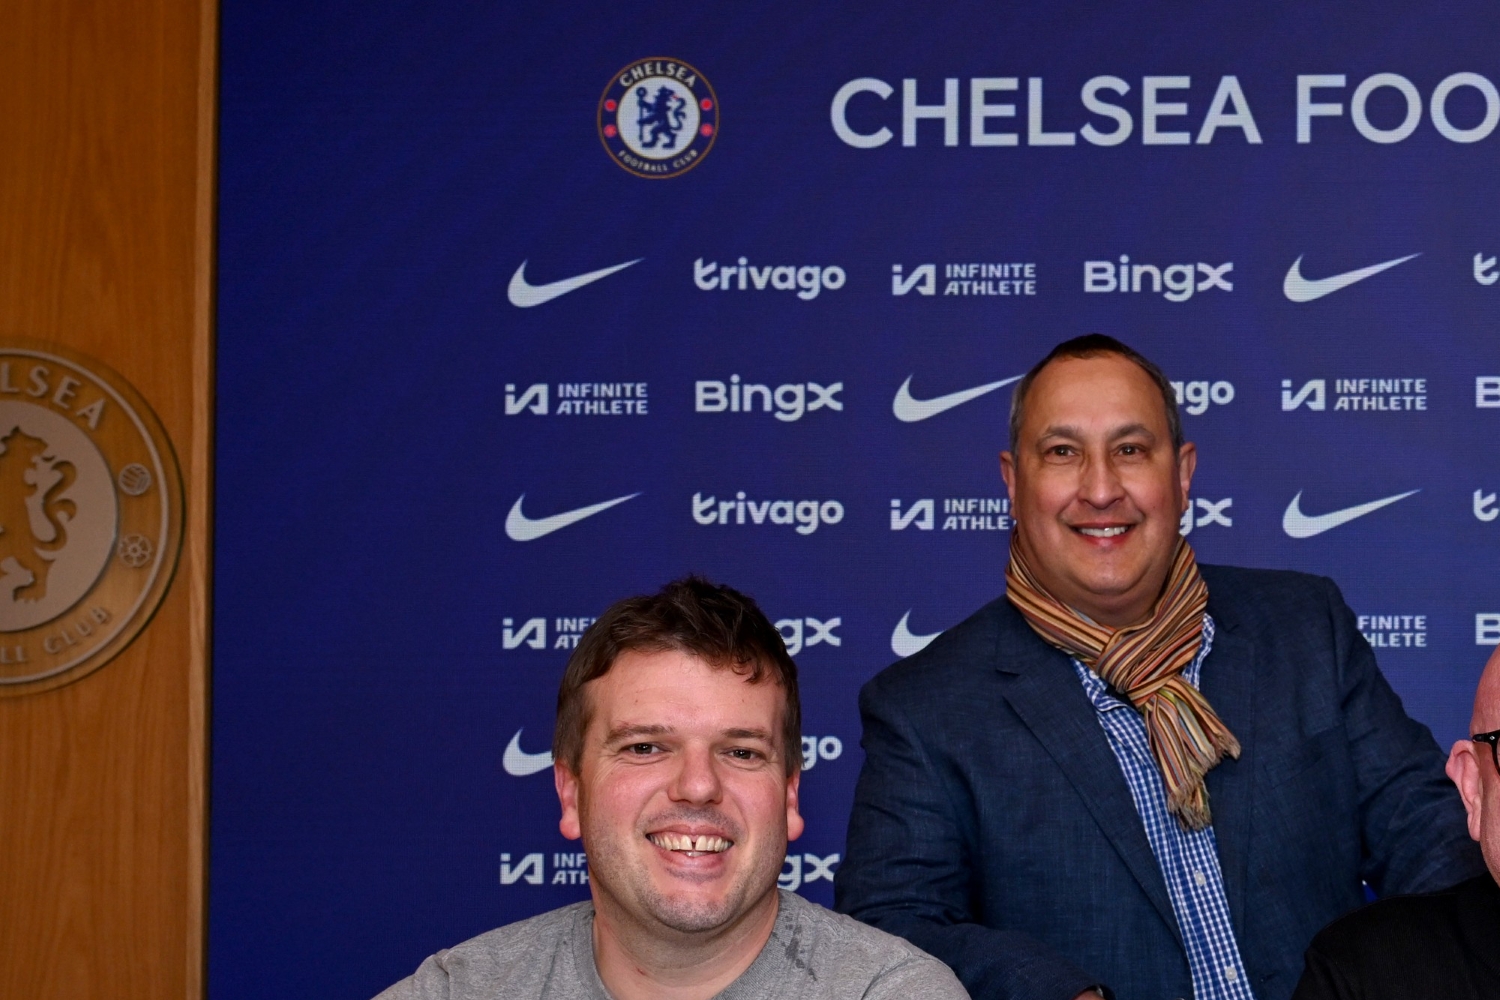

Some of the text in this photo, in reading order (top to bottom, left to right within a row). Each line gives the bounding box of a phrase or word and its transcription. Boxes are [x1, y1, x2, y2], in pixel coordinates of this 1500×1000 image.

[619, 61, 697, 87] CHELSEA
[831, 76, 1262, 148] CHELSEA
[693, 256, 846, 300] trivago
[945, 263, 1036, 278] INFINITE
[944, 280, 1036, 296] ATHLETE
[558, 382, 648, 398] INFINITE
[1335, 378, 1427, 394] INFINITE
[0, 362, 106, 430] LSEA
[1334, 395, 1427, 411] ATHLETE
[556, 399, 648, 415] ATHLETE
[692, 491, 845, 535] trivago
[944, 498, 1009, 514] INFINI
[942, 515, 1010, 530] ATHLE
[43, 606, 108, 654] CLUB
[1357, 615, 1427, 630] FINITE
[1362, 632, 1427, 648] HLETE
